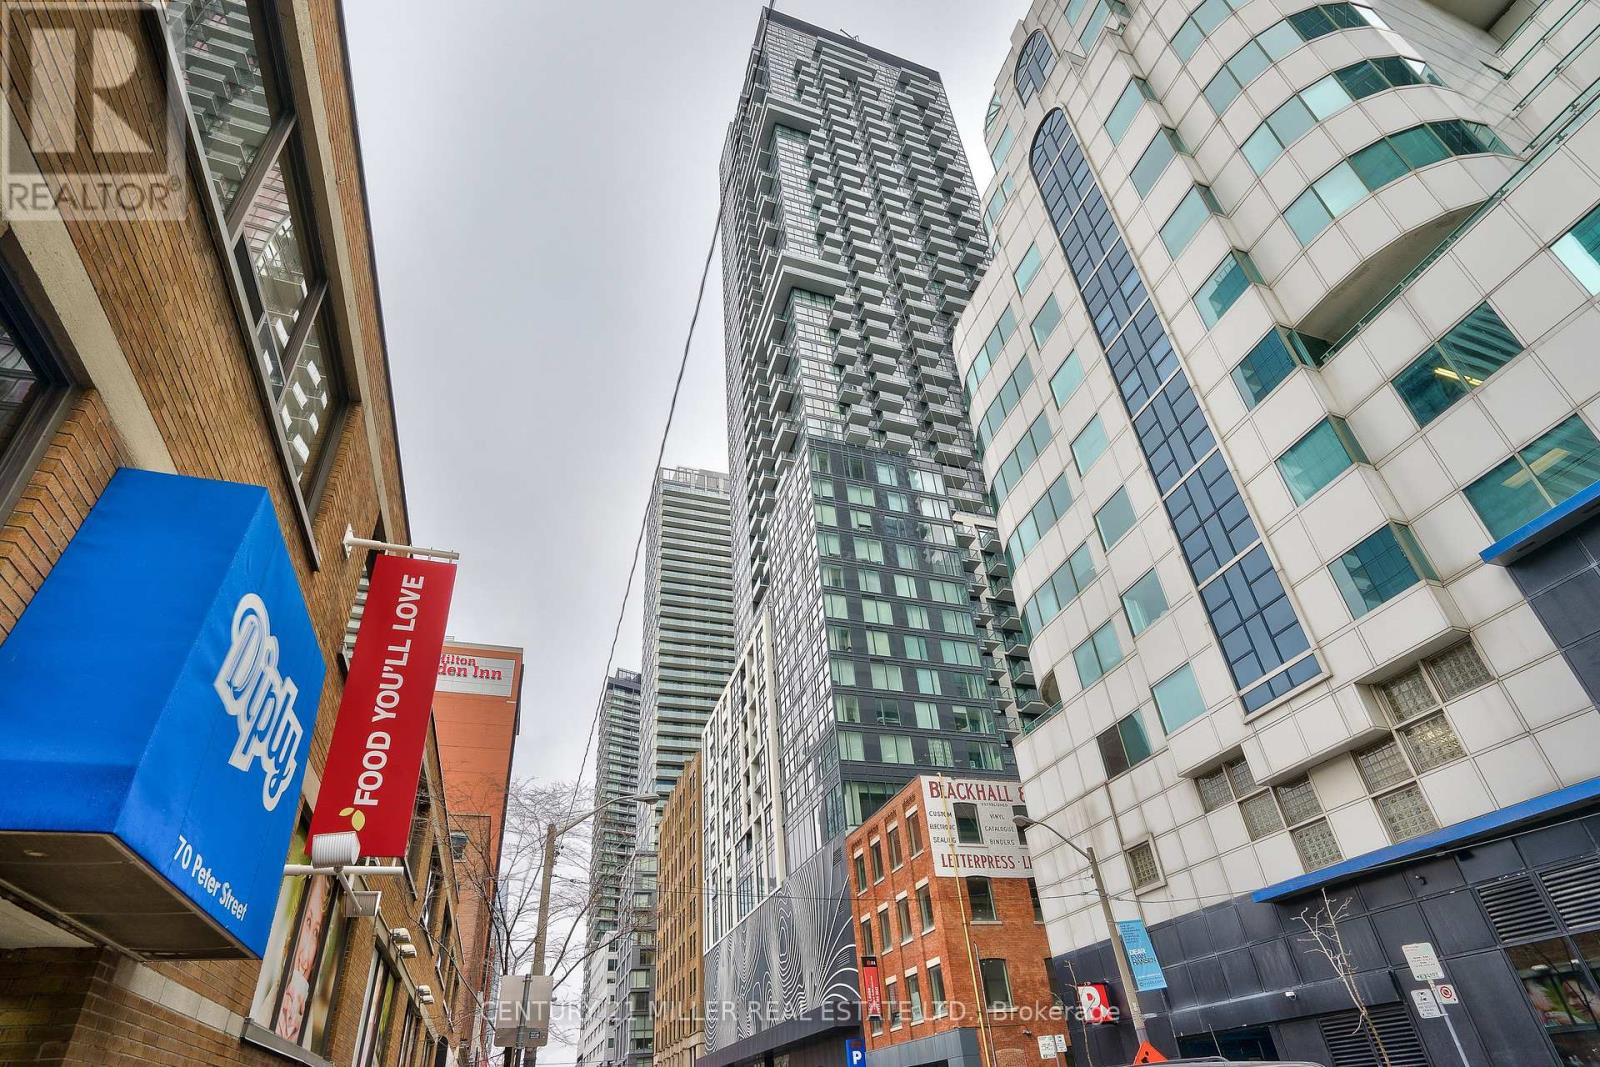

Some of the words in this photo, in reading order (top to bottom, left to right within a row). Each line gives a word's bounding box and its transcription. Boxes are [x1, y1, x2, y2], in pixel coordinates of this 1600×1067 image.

[473, 665, 503, 681] Inn
[353, 730, 391, 806] FOOD
[372, 639, 412, 723] YOU'LL
[392, 574, 424, 631] LOVE
[928, 780, 1014, 803] BLACKHALL
[989, 838, 1015, 846] BINDERS
[941, 853, 1016, 870] LETTERPRESS
[174, 834, 193, 870] 70
[191, 853, 222, 897] Peter
[219, 881, 248, 921] Street
[852, 1050, 862, 1065] P
